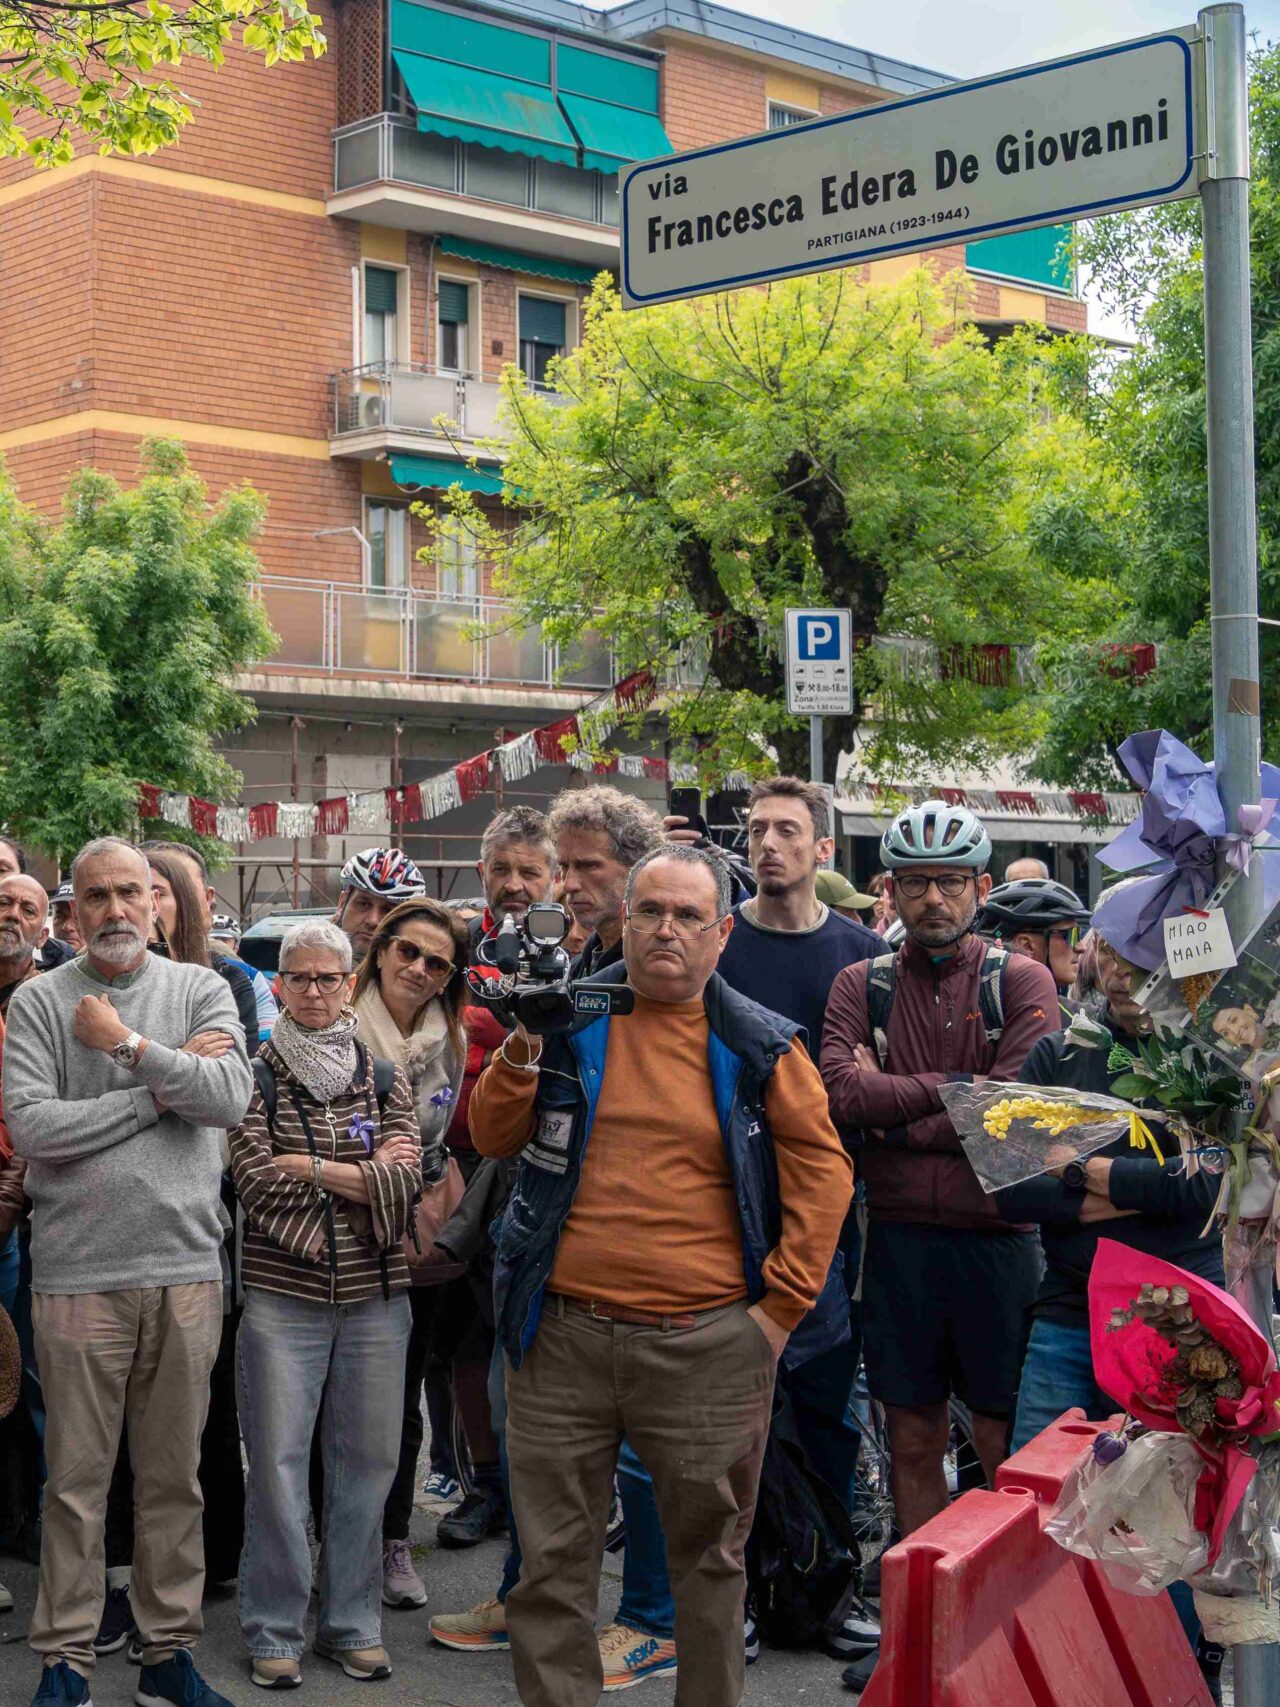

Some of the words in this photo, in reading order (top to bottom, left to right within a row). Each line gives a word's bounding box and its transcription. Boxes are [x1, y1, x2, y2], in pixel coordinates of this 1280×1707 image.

[647, 193, 805, 254] Francesca
[821, 165, 918, 216] Edera
[934, 149, 980, 191] De
[995, 98, 1169, 176] Giovanni
[647, 172, 689, 201] via
[807, 225, 888, 251] PARTIGIANA
[889, 205, 971, 236] (1923-1944)
[806, 621, 833, 657] P
[1169, 921, 1208, 941] MIAO
[1173, 941, 1213, 964] MAIA
[623, 1639, 660, 1668] HOKA
